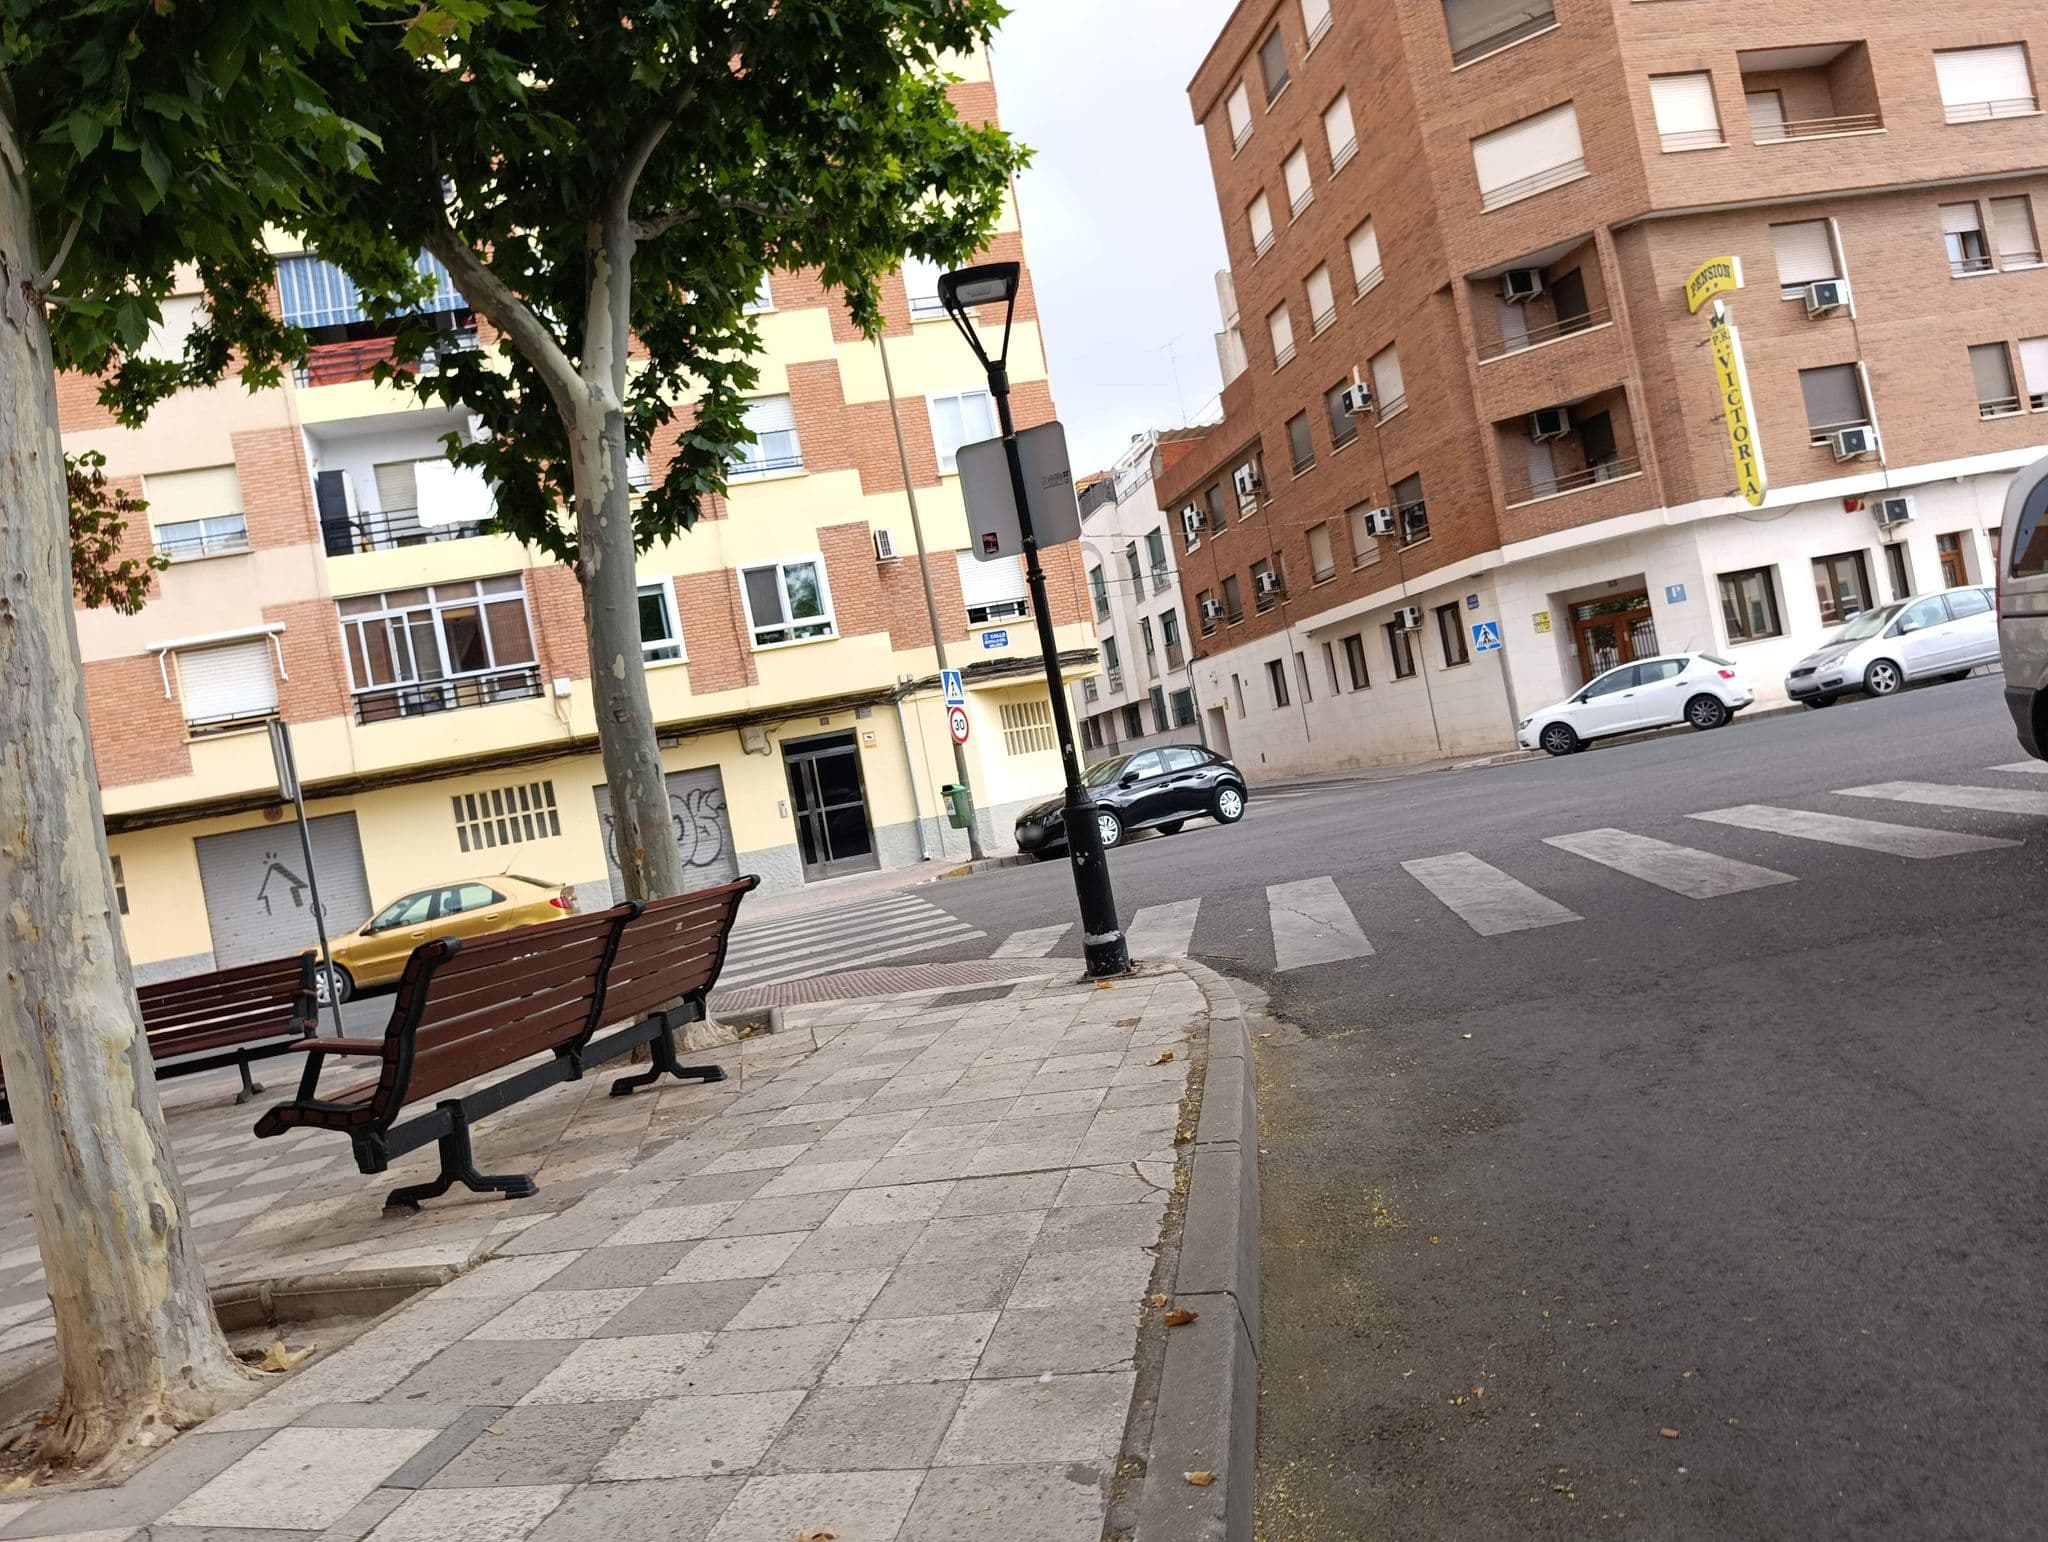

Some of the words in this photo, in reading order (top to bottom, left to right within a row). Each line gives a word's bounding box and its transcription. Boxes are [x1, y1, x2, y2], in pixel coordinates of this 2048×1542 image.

[1690, 263, 1731, 298] PENSION
[1719, 353, 1759, 497] VICTORIA
[1671, 586, 1681, 598] P
[953, 719, 965, 731] 30
